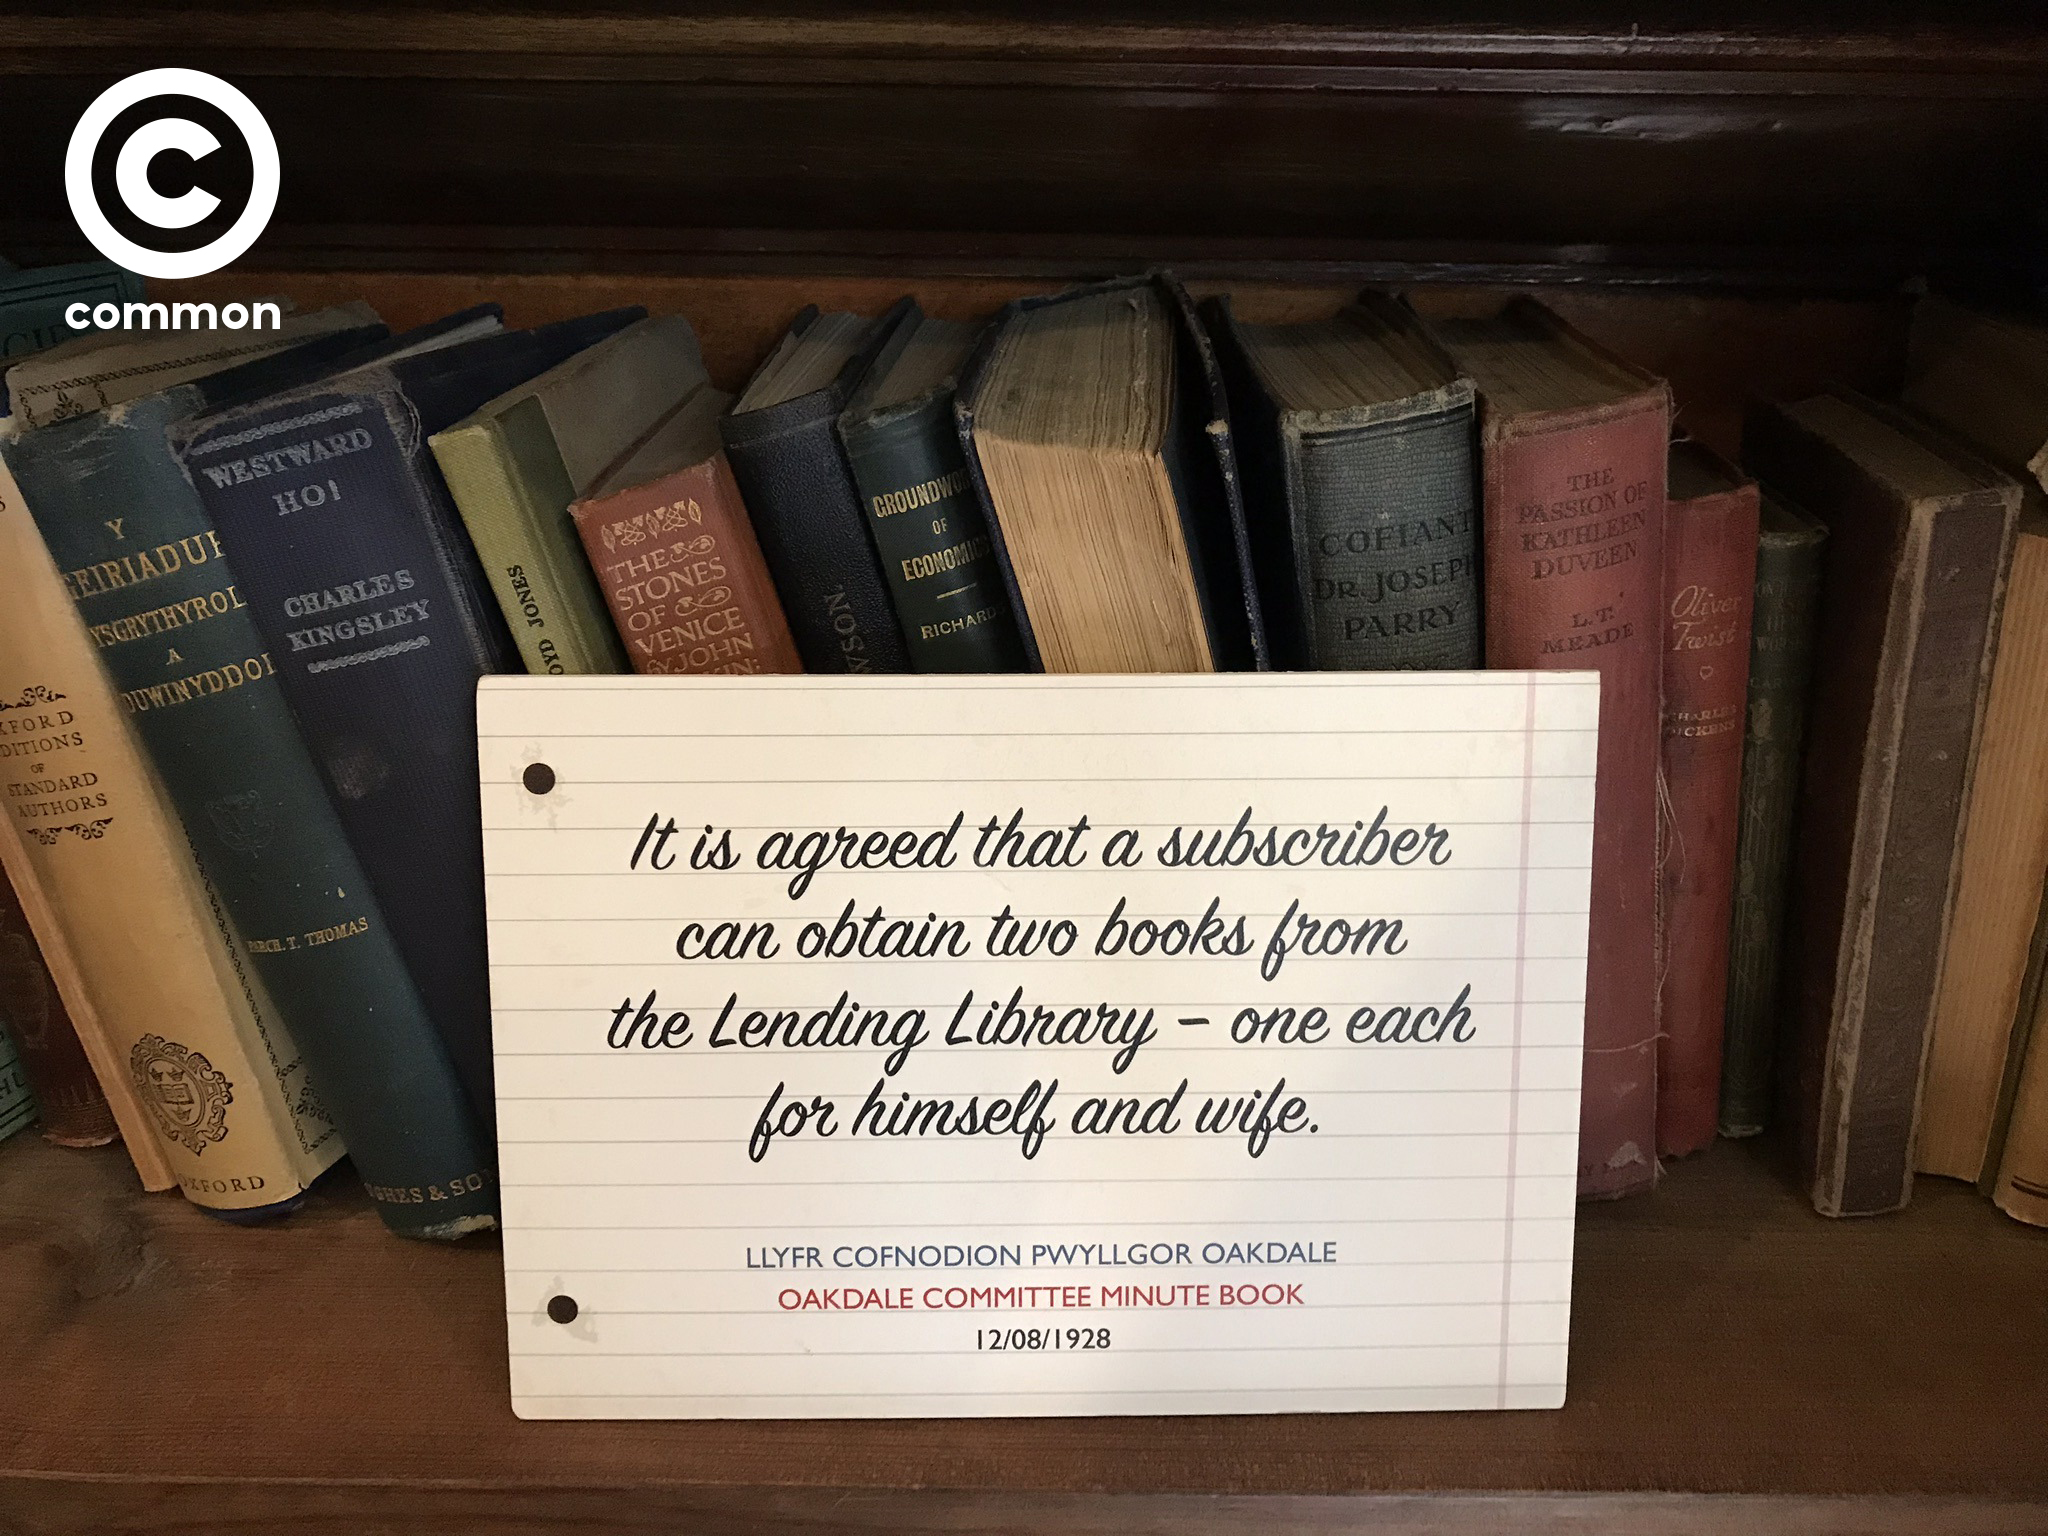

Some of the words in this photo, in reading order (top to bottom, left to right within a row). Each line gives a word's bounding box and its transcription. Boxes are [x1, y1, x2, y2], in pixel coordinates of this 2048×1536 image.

[202, 427, 373, 489] WESTWARD
[272, 479, 341, 516] HO!
[1567, 467, 1615, 492] THE
[1518, 489, 1619, 524] PASSION
[1624, 481, 1647, 505] OF
[104, 518, 125, 540] Y
[932, 517, 948, 535] OF
[1520, 509, 1646, 553] KATHLEEN
[607, 548, 670, 584] THE
[1531, 540, 1638, 580] DUVEEN
[284, 569, 415, 617] CHARLES
[507, 565, 544, 627] JONES
[615, 556, 726, 611] STONES
[1671, 585, 1742, 618] Oliver
[285, 599, 430, 652] KINGSLEY
[627, 604, 666, 632] OF
[635, 607, 745, 657] VENICE
[1344, 601, 1461, 640] PARRY
[1673, 620, 1737, 651] Twist
[166, 647, 184, 665] A
[674, 632, 754, 672] JOHN
[1541, 622, 1634, 654] MEADE
[7, 772, 98, 797] STANDARD
[30, 763, 45, 774] OF
[17, 793, 108, 818] AUTHORS
[631, 812, 677, 871] It
[690, 824, 740, 870] is
[757, 811, 964, 900] agreed
[973, 807, 1091, 868] that
[1102, 827, 1143, 867] a
[1157, 806, 1452, 867] subscriber
[286, 936, 301, 950] T.
[304, 916, 368, 946] THOMAS
[676, 922, 780, 959] can
[796, 898, 971, 958] obtain
[986, 905, 1079, 957] two
[1095, 896, 1255, 956] books
[1261, 898, 1409, 982] from
[607, 989, 693, 1049] the
[708, 990, 930, 1077] Lending
[945, 985, 1158, 1075] Library
[1230, 1006, 1330, 1044] one
[1345, 983, 1476, 1044] each
[748, 1081, 838, 1163] for
[851, 1077, 1059, 1160] himself
[1071, 1078, 1188, 1134] and
[1195, 1077, 1319, 1159] wife.
[428, 1185, 449, 1201] &
[746, 1246, 824, 1269] LLYFR
[832, 1244, 1022, 1269] COFNODION
[1032, 1243, 1193, 1267] PWYLLGOR
[1201, 1241, 1338, 1265] OAKDALE
[778, 1287, 914, 1311] OAKDALE
[922, 1286, 1092, 1310] COMMITTEE
[1101, 1284, 1210, 1308] MINUTE
[1220, 1283, 1305, 1307] BOOK
[976, 1327, 1111, 1352] 12/08/1928
